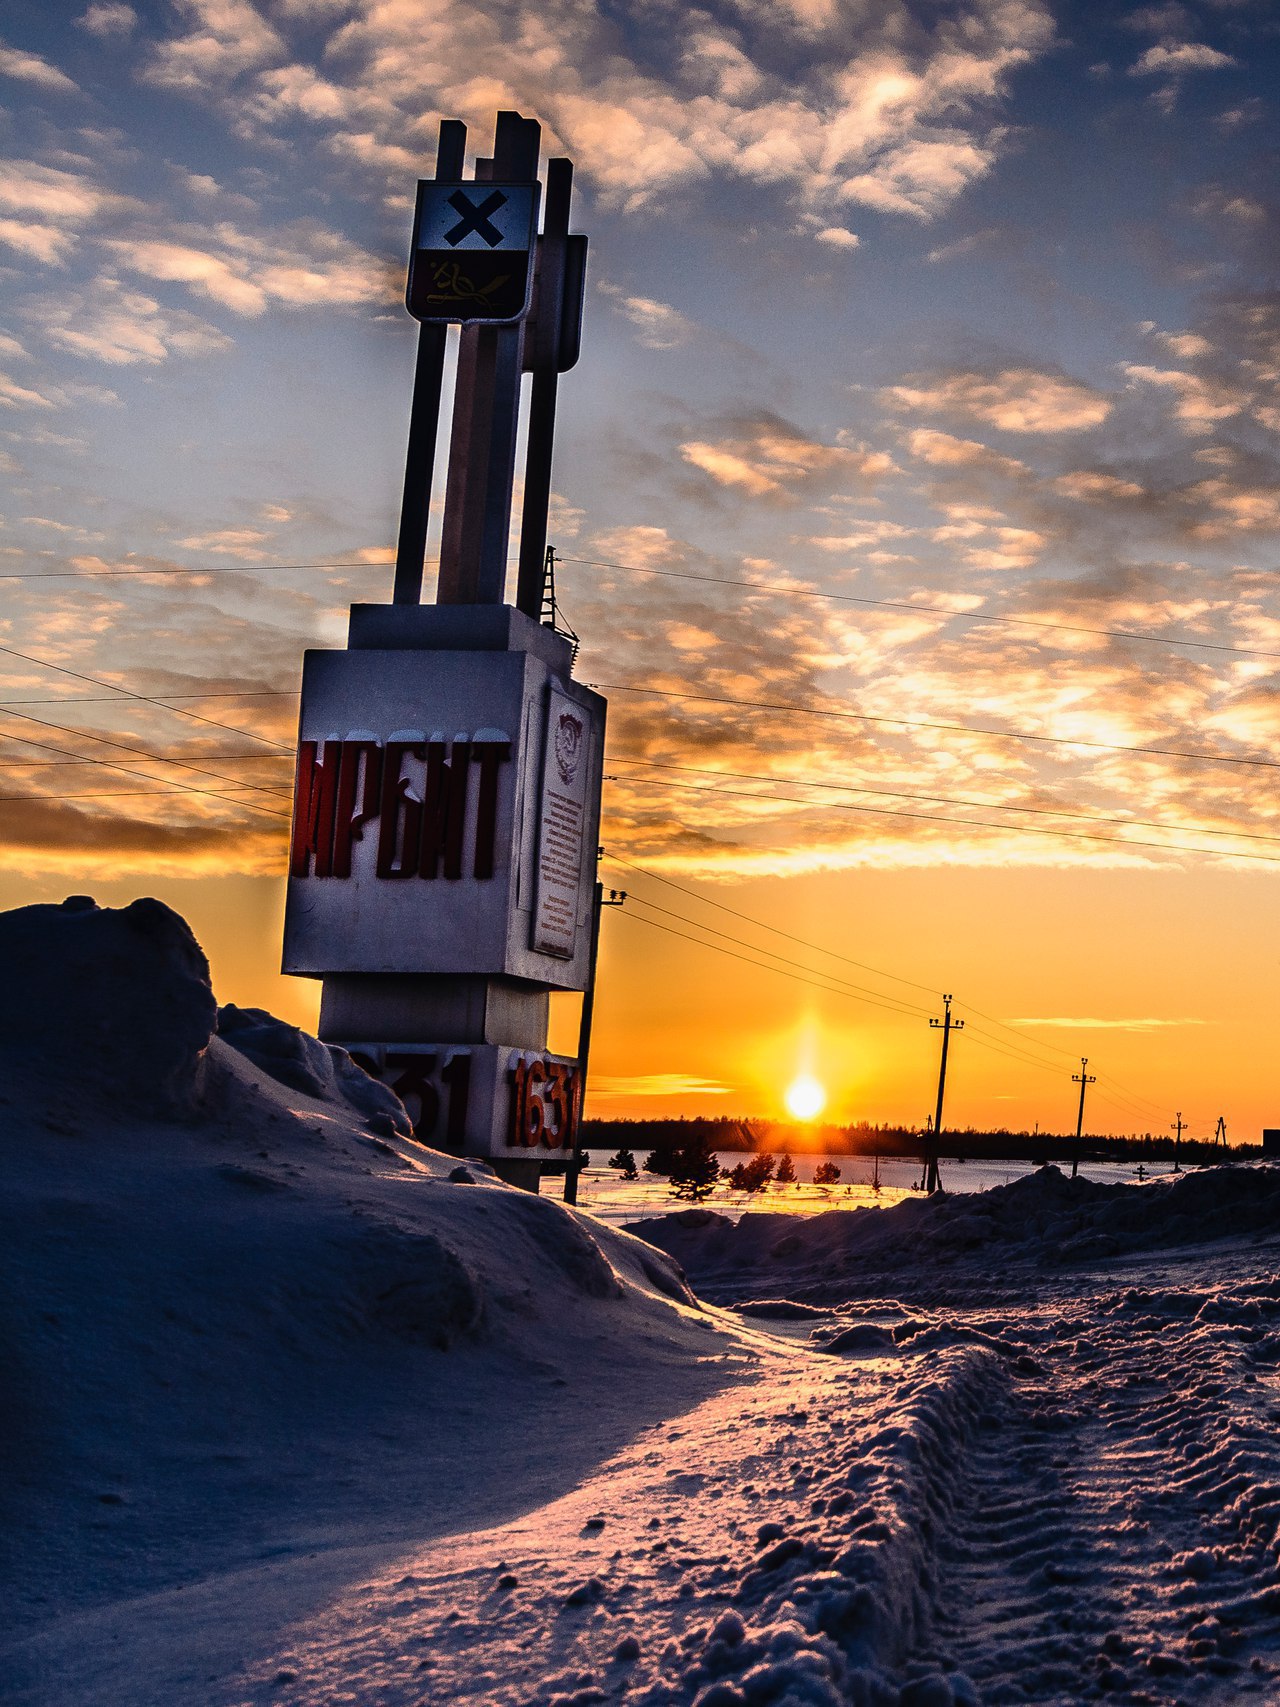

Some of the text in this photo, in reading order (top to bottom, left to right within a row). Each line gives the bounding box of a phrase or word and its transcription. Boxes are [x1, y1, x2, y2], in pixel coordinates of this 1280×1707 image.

[292, 742, 510, 879] ИРБИТ
[348, 1052, 471, 1146] 31
[507, 1058, 581, 1149] 1631
